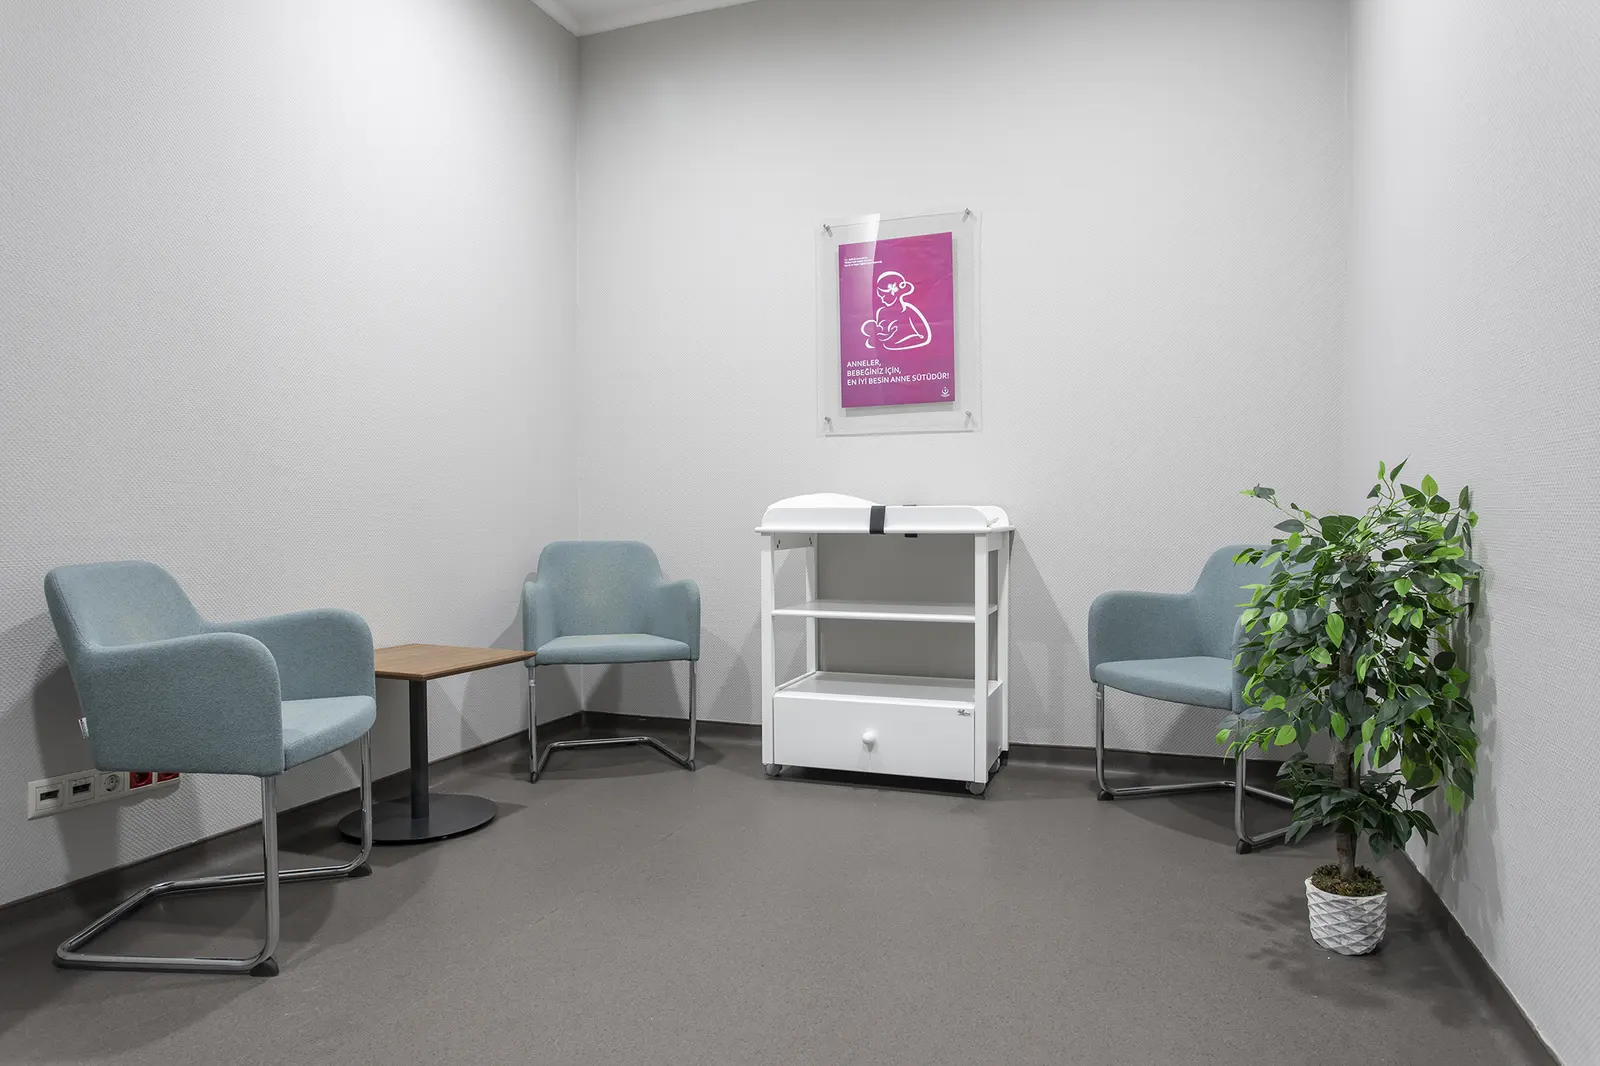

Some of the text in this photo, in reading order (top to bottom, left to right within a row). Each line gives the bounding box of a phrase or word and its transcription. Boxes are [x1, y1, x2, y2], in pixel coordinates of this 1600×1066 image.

[847, 359, 881, 368] ANNELER,
[847, 367, 883, 377] BEBEĞİNİZ
[868, 376, 889, 385] BESİN
[890, 374, 910, 383] ANNE
[912, 372, 949, 381] SÜTÜDÜR!
